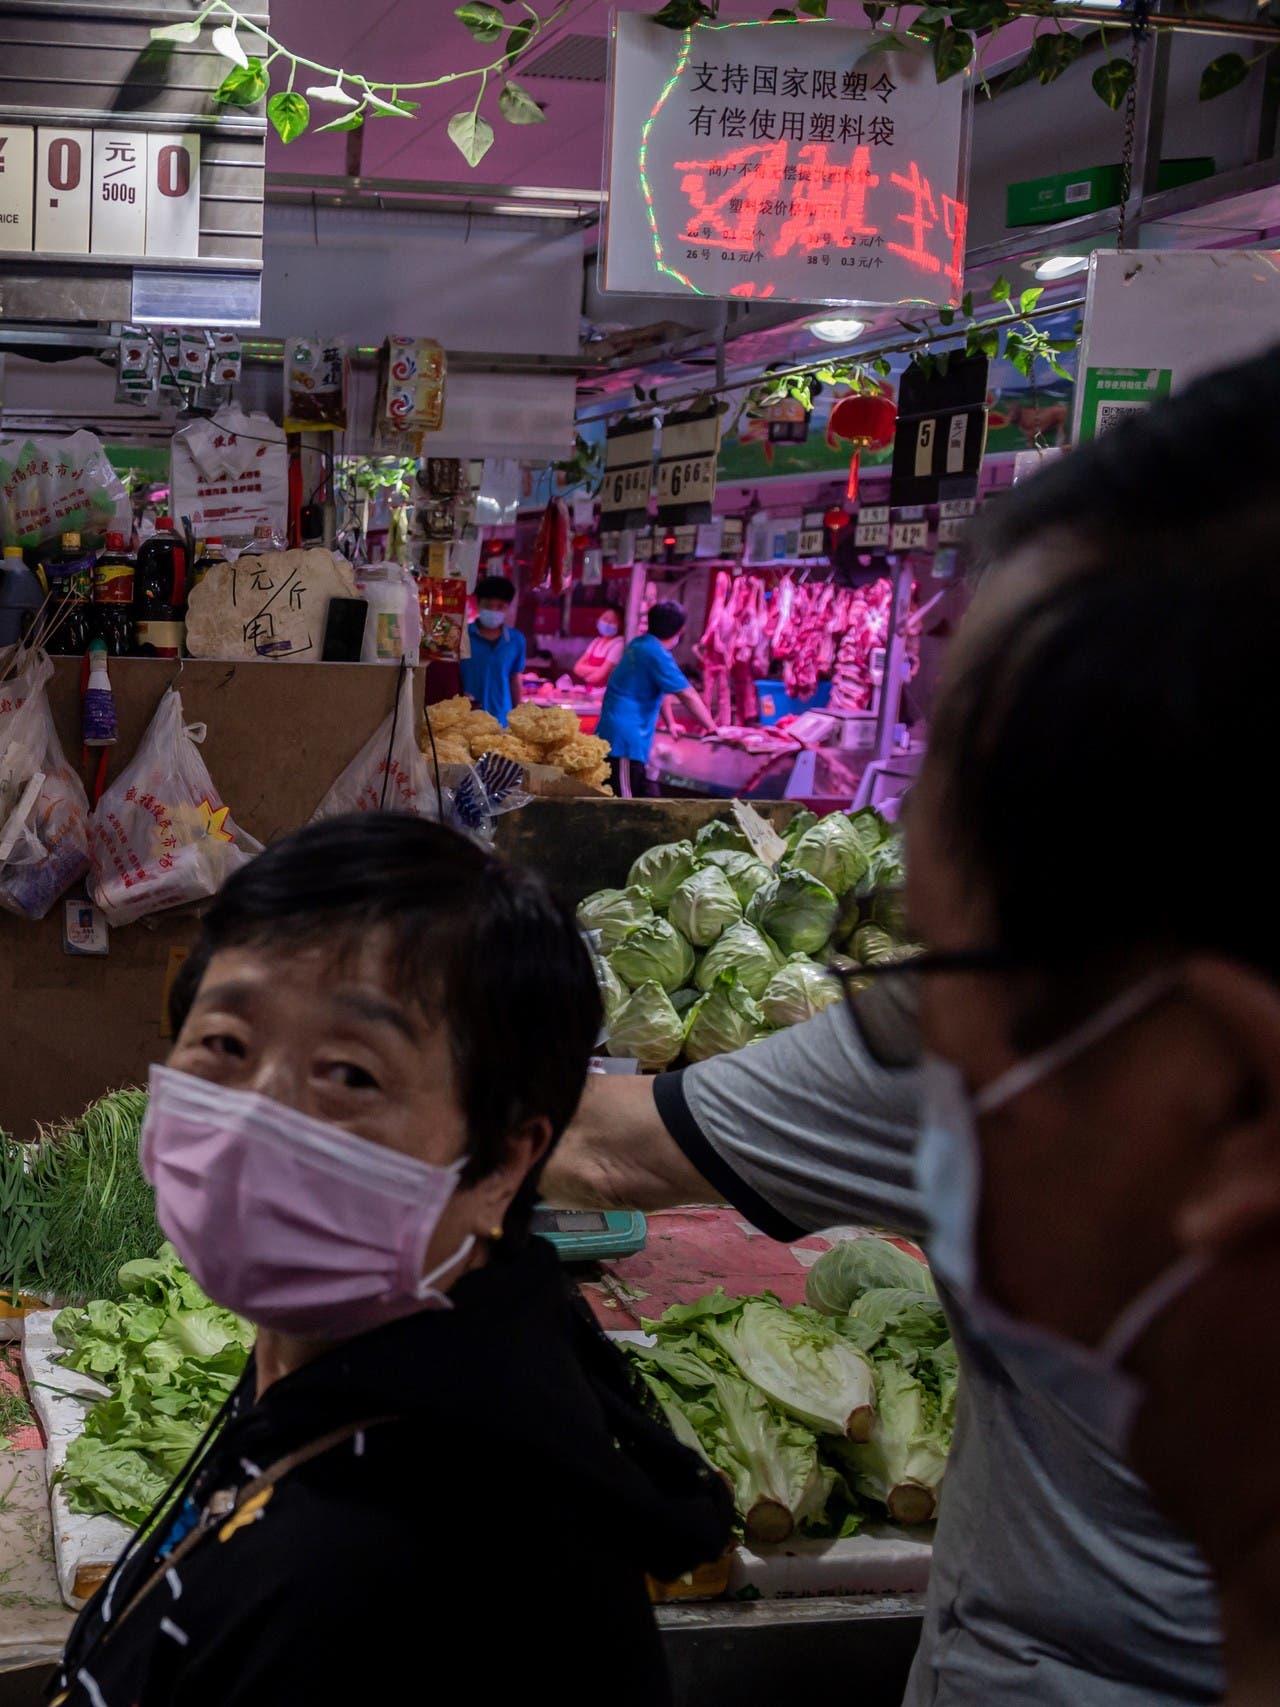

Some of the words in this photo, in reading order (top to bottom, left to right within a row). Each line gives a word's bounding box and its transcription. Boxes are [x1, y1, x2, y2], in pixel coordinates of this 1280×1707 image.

[689, 61, 898, 104] 支持国家限塑令
[688, 104, 895, 147] 有偿使用塑料袋
[157, 144, 190, 198] 0
[686, 249, 698, 260] 26
[701, 248, 711, 261] 号
[721, 250, 735, 261] 0.1
[738, 250, 765, 263] 元/个
[806, 255, 818, 266] 38
[821, 254, 831, 267] 号
[840, 256, 856, 267] 0.3
[859, 256, 884, 269] 元/个
[1096, 379, 1156, 392] 推荐使用微信
[920, 423, 931, 448] 5
